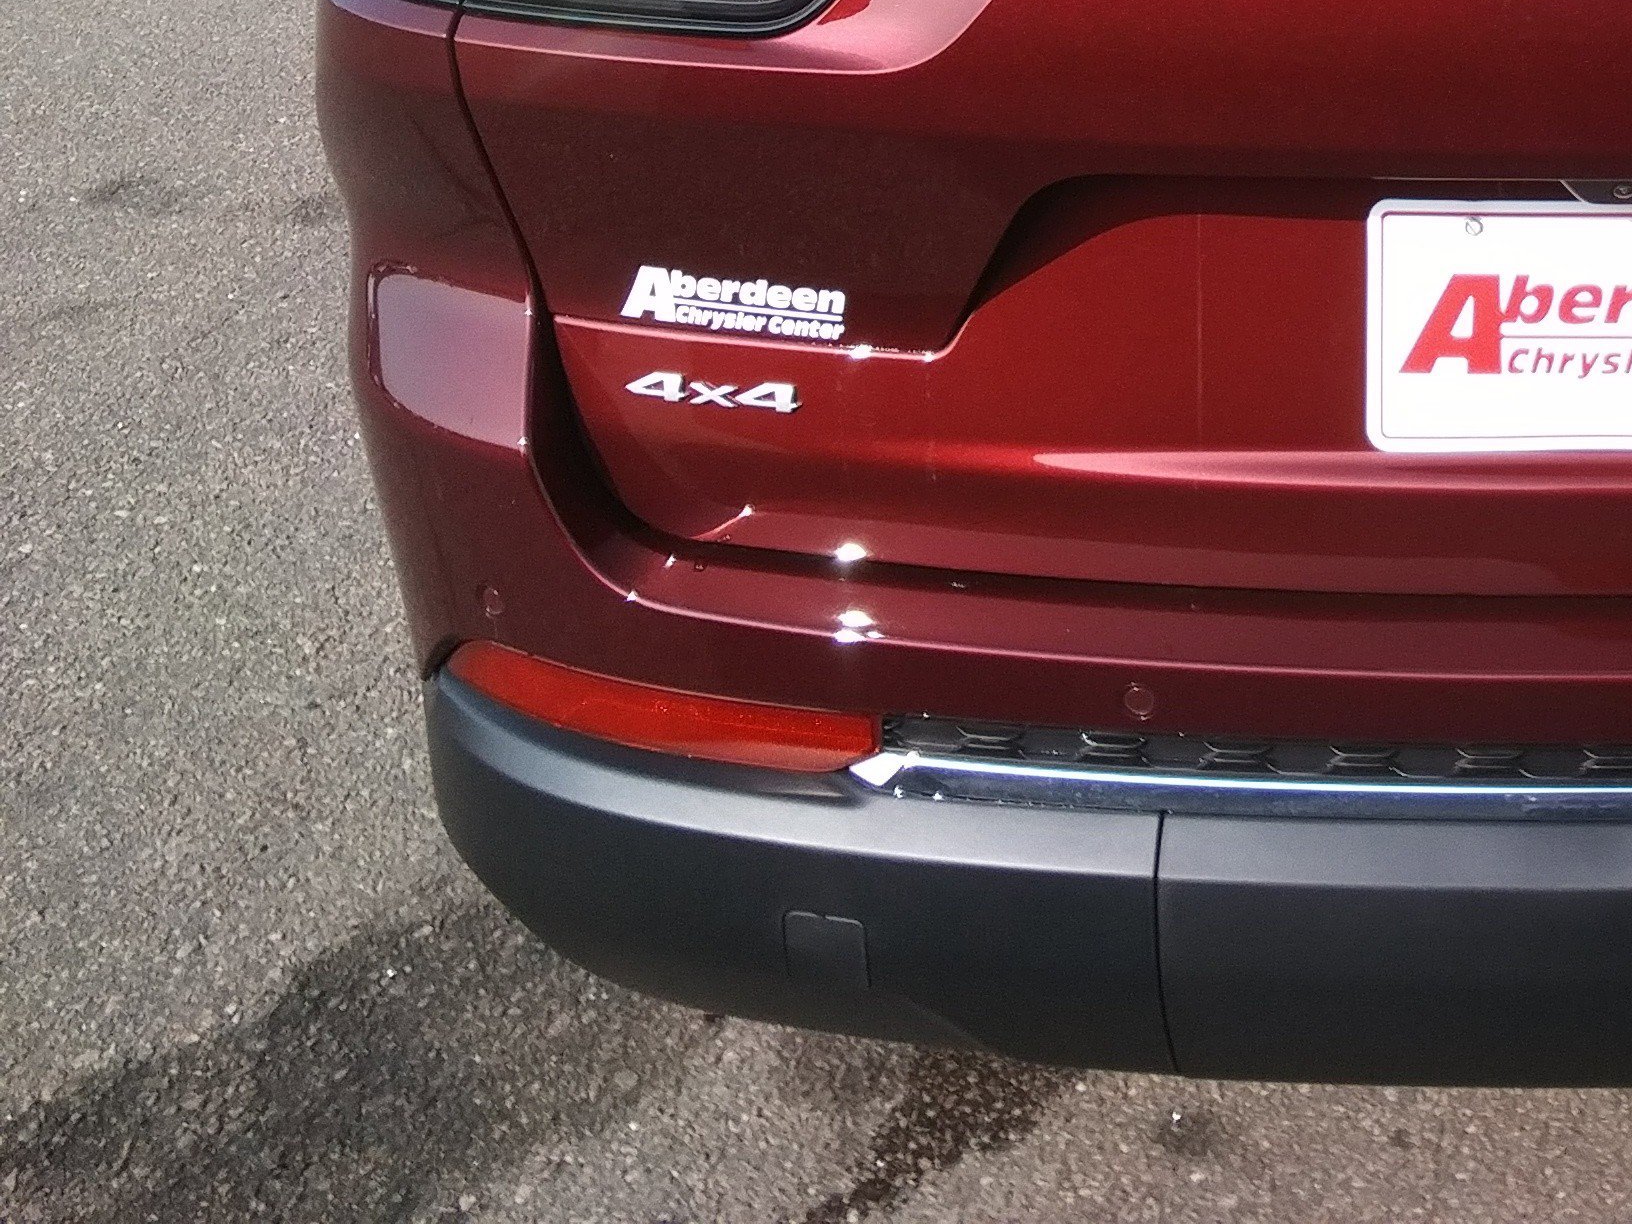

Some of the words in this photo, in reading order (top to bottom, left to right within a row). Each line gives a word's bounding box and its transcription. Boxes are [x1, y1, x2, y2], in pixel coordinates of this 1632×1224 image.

[620, 265, 846, 323] Aberdeen
[675, 305, 768, 332] Chrysler
[767, 316, 846, 340] Center
[625, 371, 803, 413] 4x4
